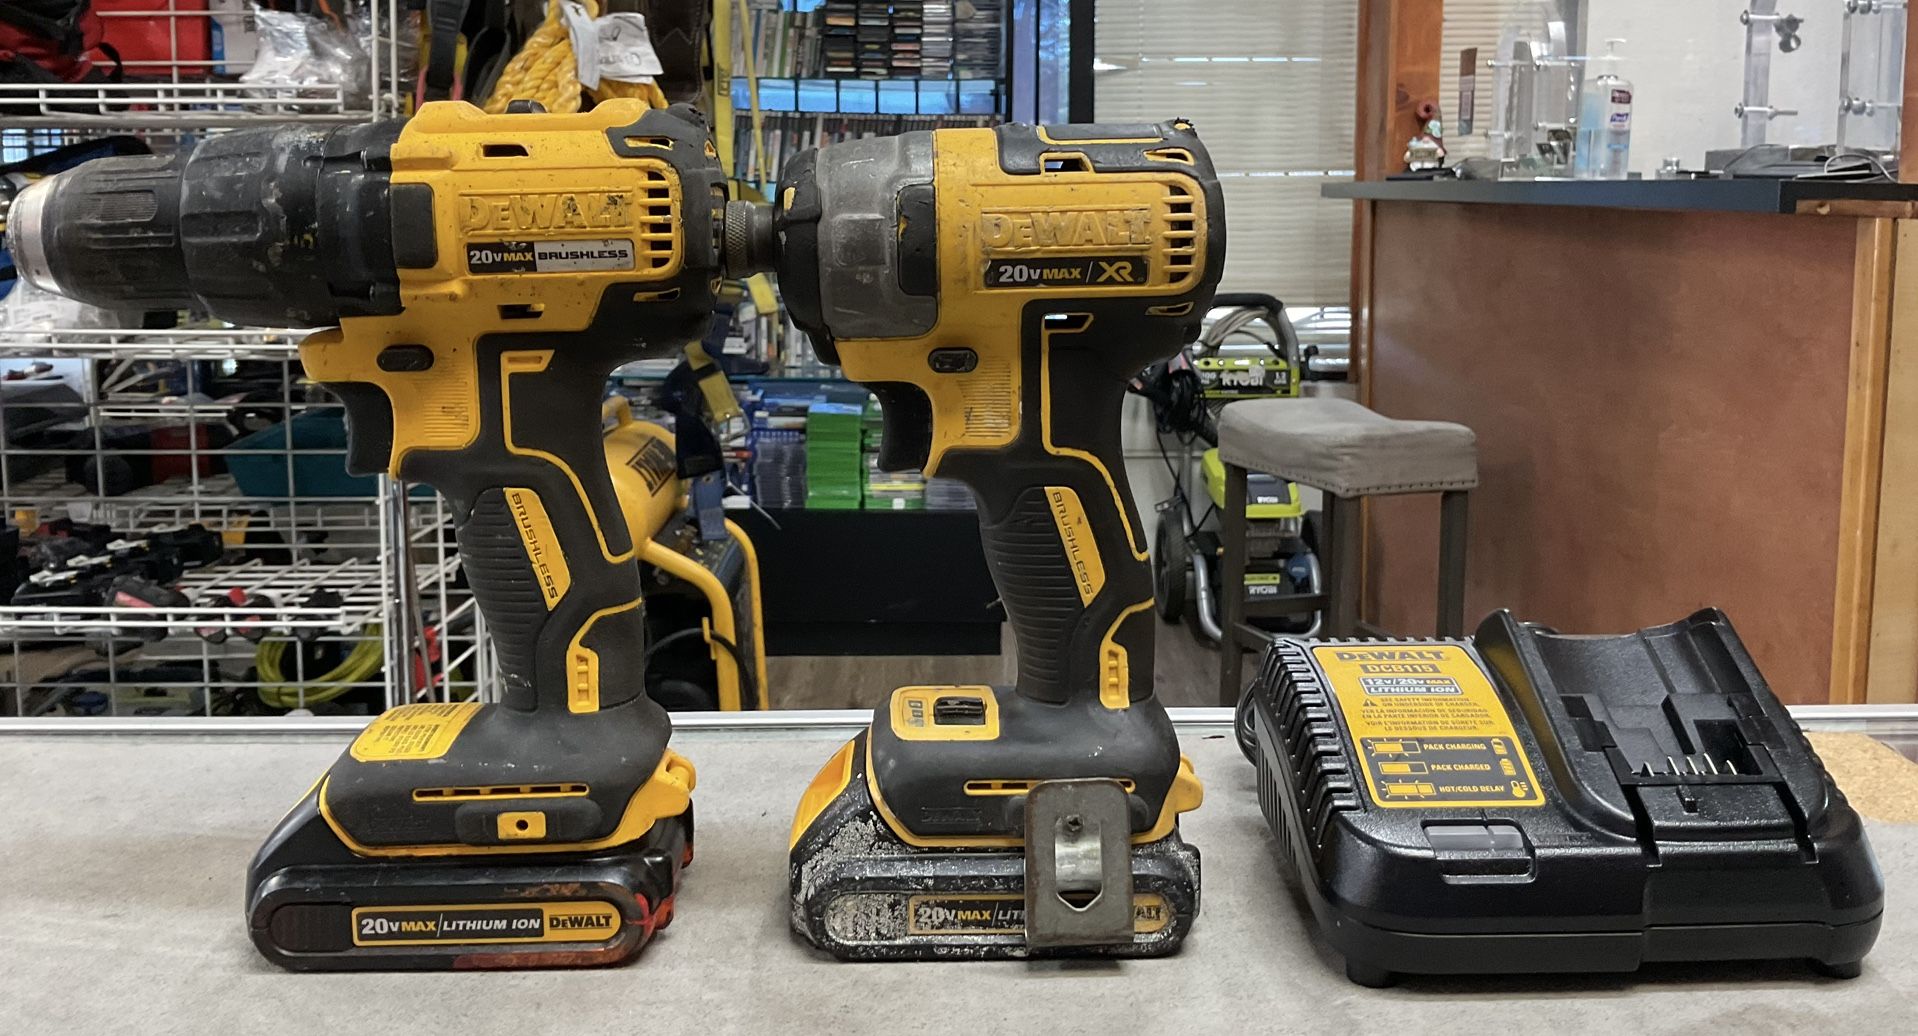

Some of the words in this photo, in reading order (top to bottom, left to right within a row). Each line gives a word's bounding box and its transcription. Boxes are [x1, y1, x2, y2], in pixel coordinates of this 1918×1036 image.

[503, 251, 534, 262] MAX
[537, 249, 629, 260] BRUSHLESS
[1043, 268, 1082, 279] MAX
[1096, 261, 1134, 282] XR
[512, 493, 558, 599] BRUSHLESS
[1053, 492, 1093, 594] BRUSHLESS
[1367, 664, 1433, 672] DCB115
[957, 909, 992, 921] MAX
[401, 921, 437, 933] MAX
[443, 918, 507, 932] LITHIUM
[512, 917, 541, 930] ION
[549, 914, 612, 929] DEWALT
